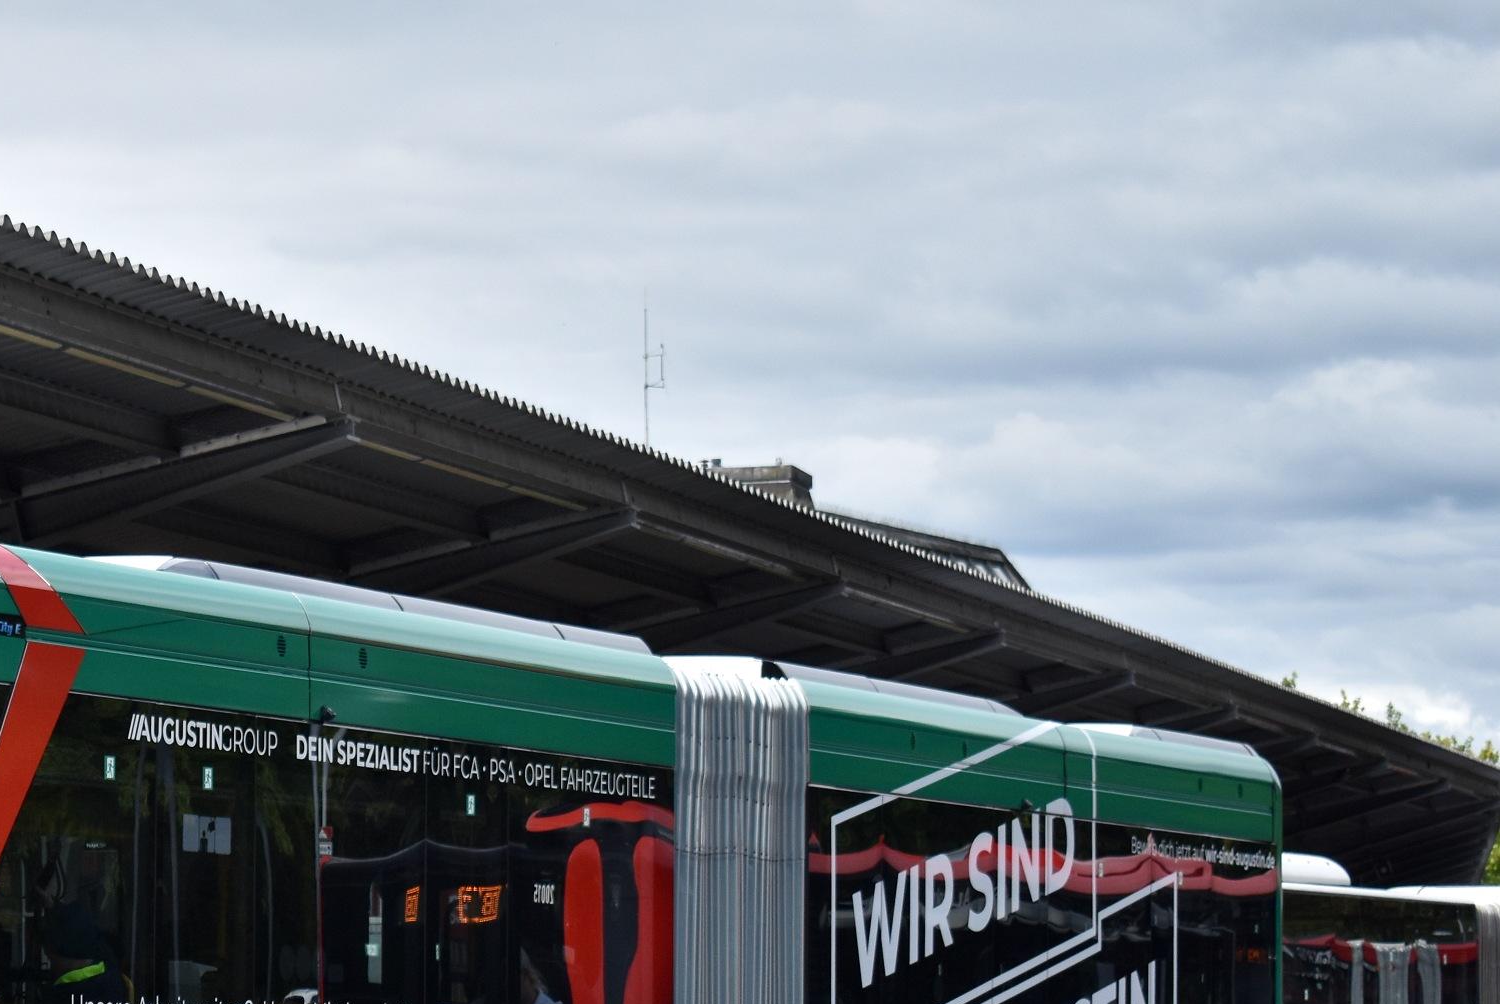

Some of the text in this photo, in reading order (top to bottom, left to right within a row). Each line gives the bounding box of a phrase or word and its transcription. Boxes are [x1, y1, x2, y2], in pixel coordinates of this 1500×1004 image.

[15, 624, 22, 635] E
[296, 734, 333, 763] DEIN
[337, 738, 420, 773] SPEZIALIST
[422, 747, 450, 776] FÜR
[453, 754, 480, 780] FCA
[490, 758, 516, 784] PSA
[524, 763, 558, 789] OPEL
[560, 766, 656, 799] FAHRZEUGTEILE
[852, 798, 1075, 989] WIR SIND
